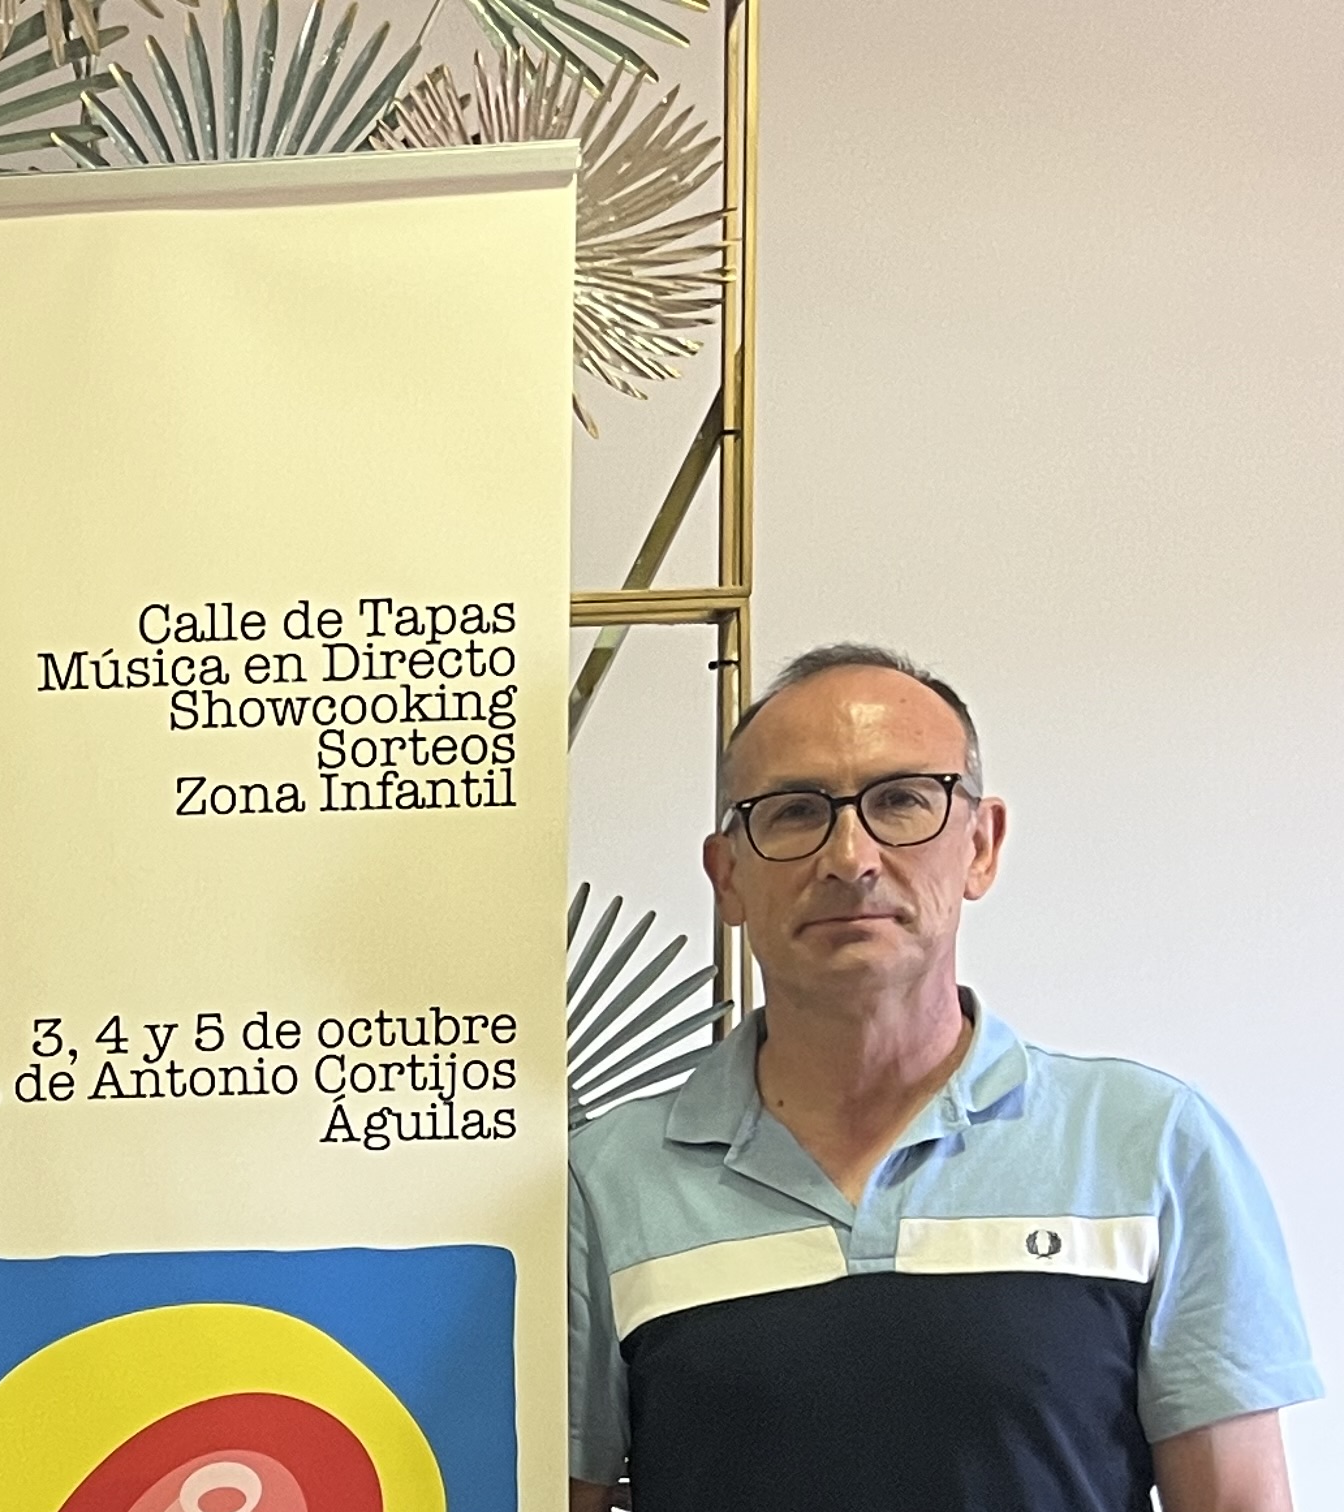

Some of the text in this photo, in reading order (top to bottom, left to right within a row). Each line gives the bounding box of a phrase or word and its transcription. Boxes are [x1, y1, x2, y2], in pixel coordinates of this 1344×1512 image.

[138, 598, 516, 645] Calle de Tapas
[37, 640, 516, 692] Música en Directo
[170, 683, 518, 731] Showcooking
[317, 729, 516, 770] Sorteos
[176, 768, 517, 815] Zona Infantil
[30, 1006, 517, 1065] 3, 4 y 5 de octubre
[14, 1063, 76, 1103] de
[87, 1056, 299, 1101] Antonio
[314, 1052, 517, 1103] Cortijos
[319, 1096, 517, 1151] Águilas
